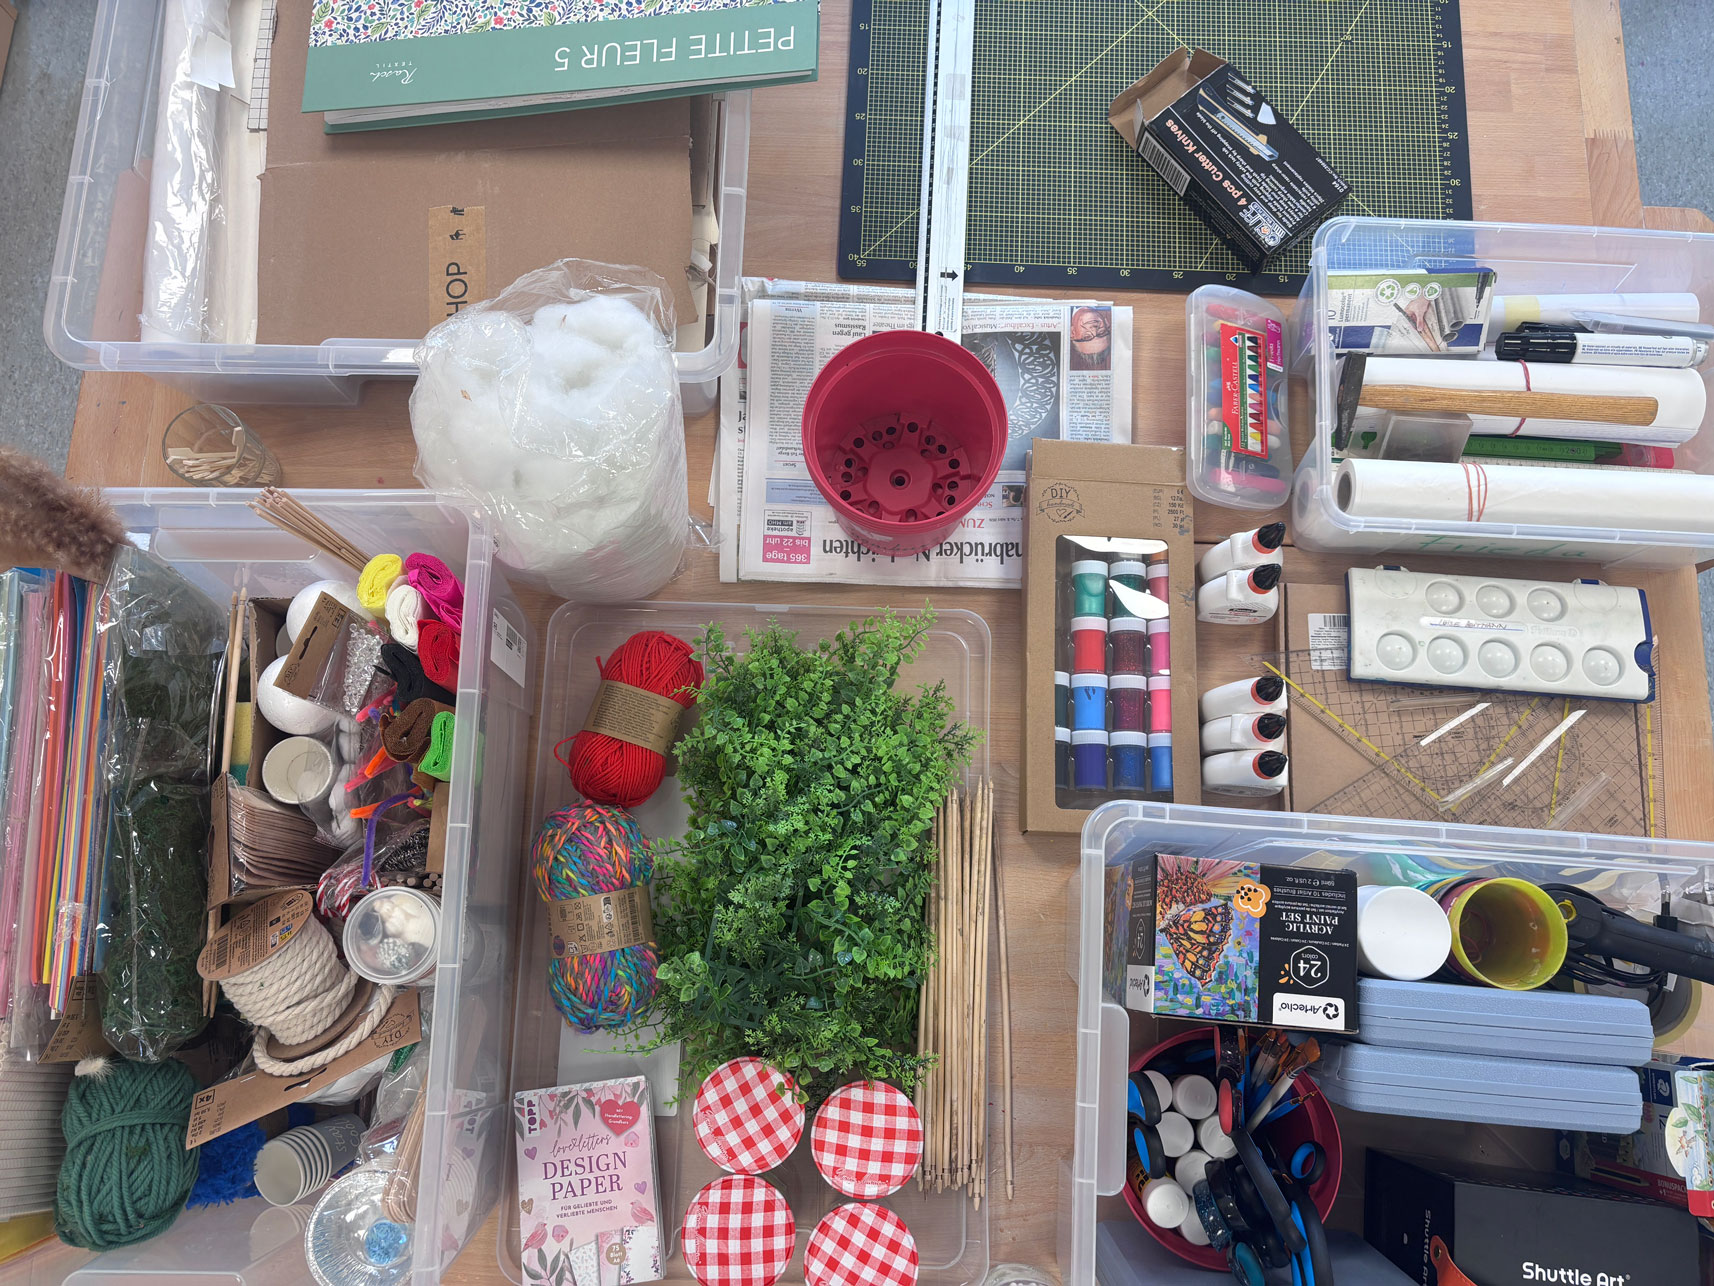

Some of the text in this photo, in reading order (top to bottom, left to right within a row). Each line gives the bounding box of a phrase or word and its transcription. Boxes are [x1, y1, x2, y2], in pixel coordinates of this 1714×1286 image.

[553, 25, 794, 72] PETITE FLEUR 5
[1445, 86, 1455, 94] 20
[1163, 119, 1197, 154] Knives
[1192, 150, 1224, 182] Cutter
[1222, 178, 1242, 199] pcs
[1450, 178, 1461, 186] 30
[1237, 197, 1248, 208] 4
[446, 262, 468, 317] HOP
[834, 322, 866, 330] Rassismus
[1231, 361, 1239, 415] FABER-CASTELL
[1051, 488, 1071, 498] DIY
[766, 537, 780, 545] uhr
[795, 538, 808, 546] bis
[1417, 535, 1587, 559] Frieda
[766, 550, 807, 561] 365 tage
[936, 541, 1022, 565] nabrücker
[1321, 891, 1346, 899] Includes
[1280, 911, 1339, 925] PAINT SET
[1284, 922, 1334, 935] ACRYLIC
[1300, 952, 1318, 960] colors
[1297, 959, 1321, 977] 24
[380, 1030, 403, 1045] DIY
[197, 1094, 213, 1104] 4x
[527, 1099, 537, 1134] TOPP
[542, 1150, 628, 1180] DESIGN
[550, 1174, 623, 1201] PAPER
[556, 1205, 618, 1219] VERLIEBTE MENSCHEN
[560, 1203, 572, 1211] FÜR
[572, 1201, 599, 1210] GELIEBTE
[1423, 1209, 1431, 1264] Shuttle
[1522, 1261, 1625, 1286] Shuttle Art
